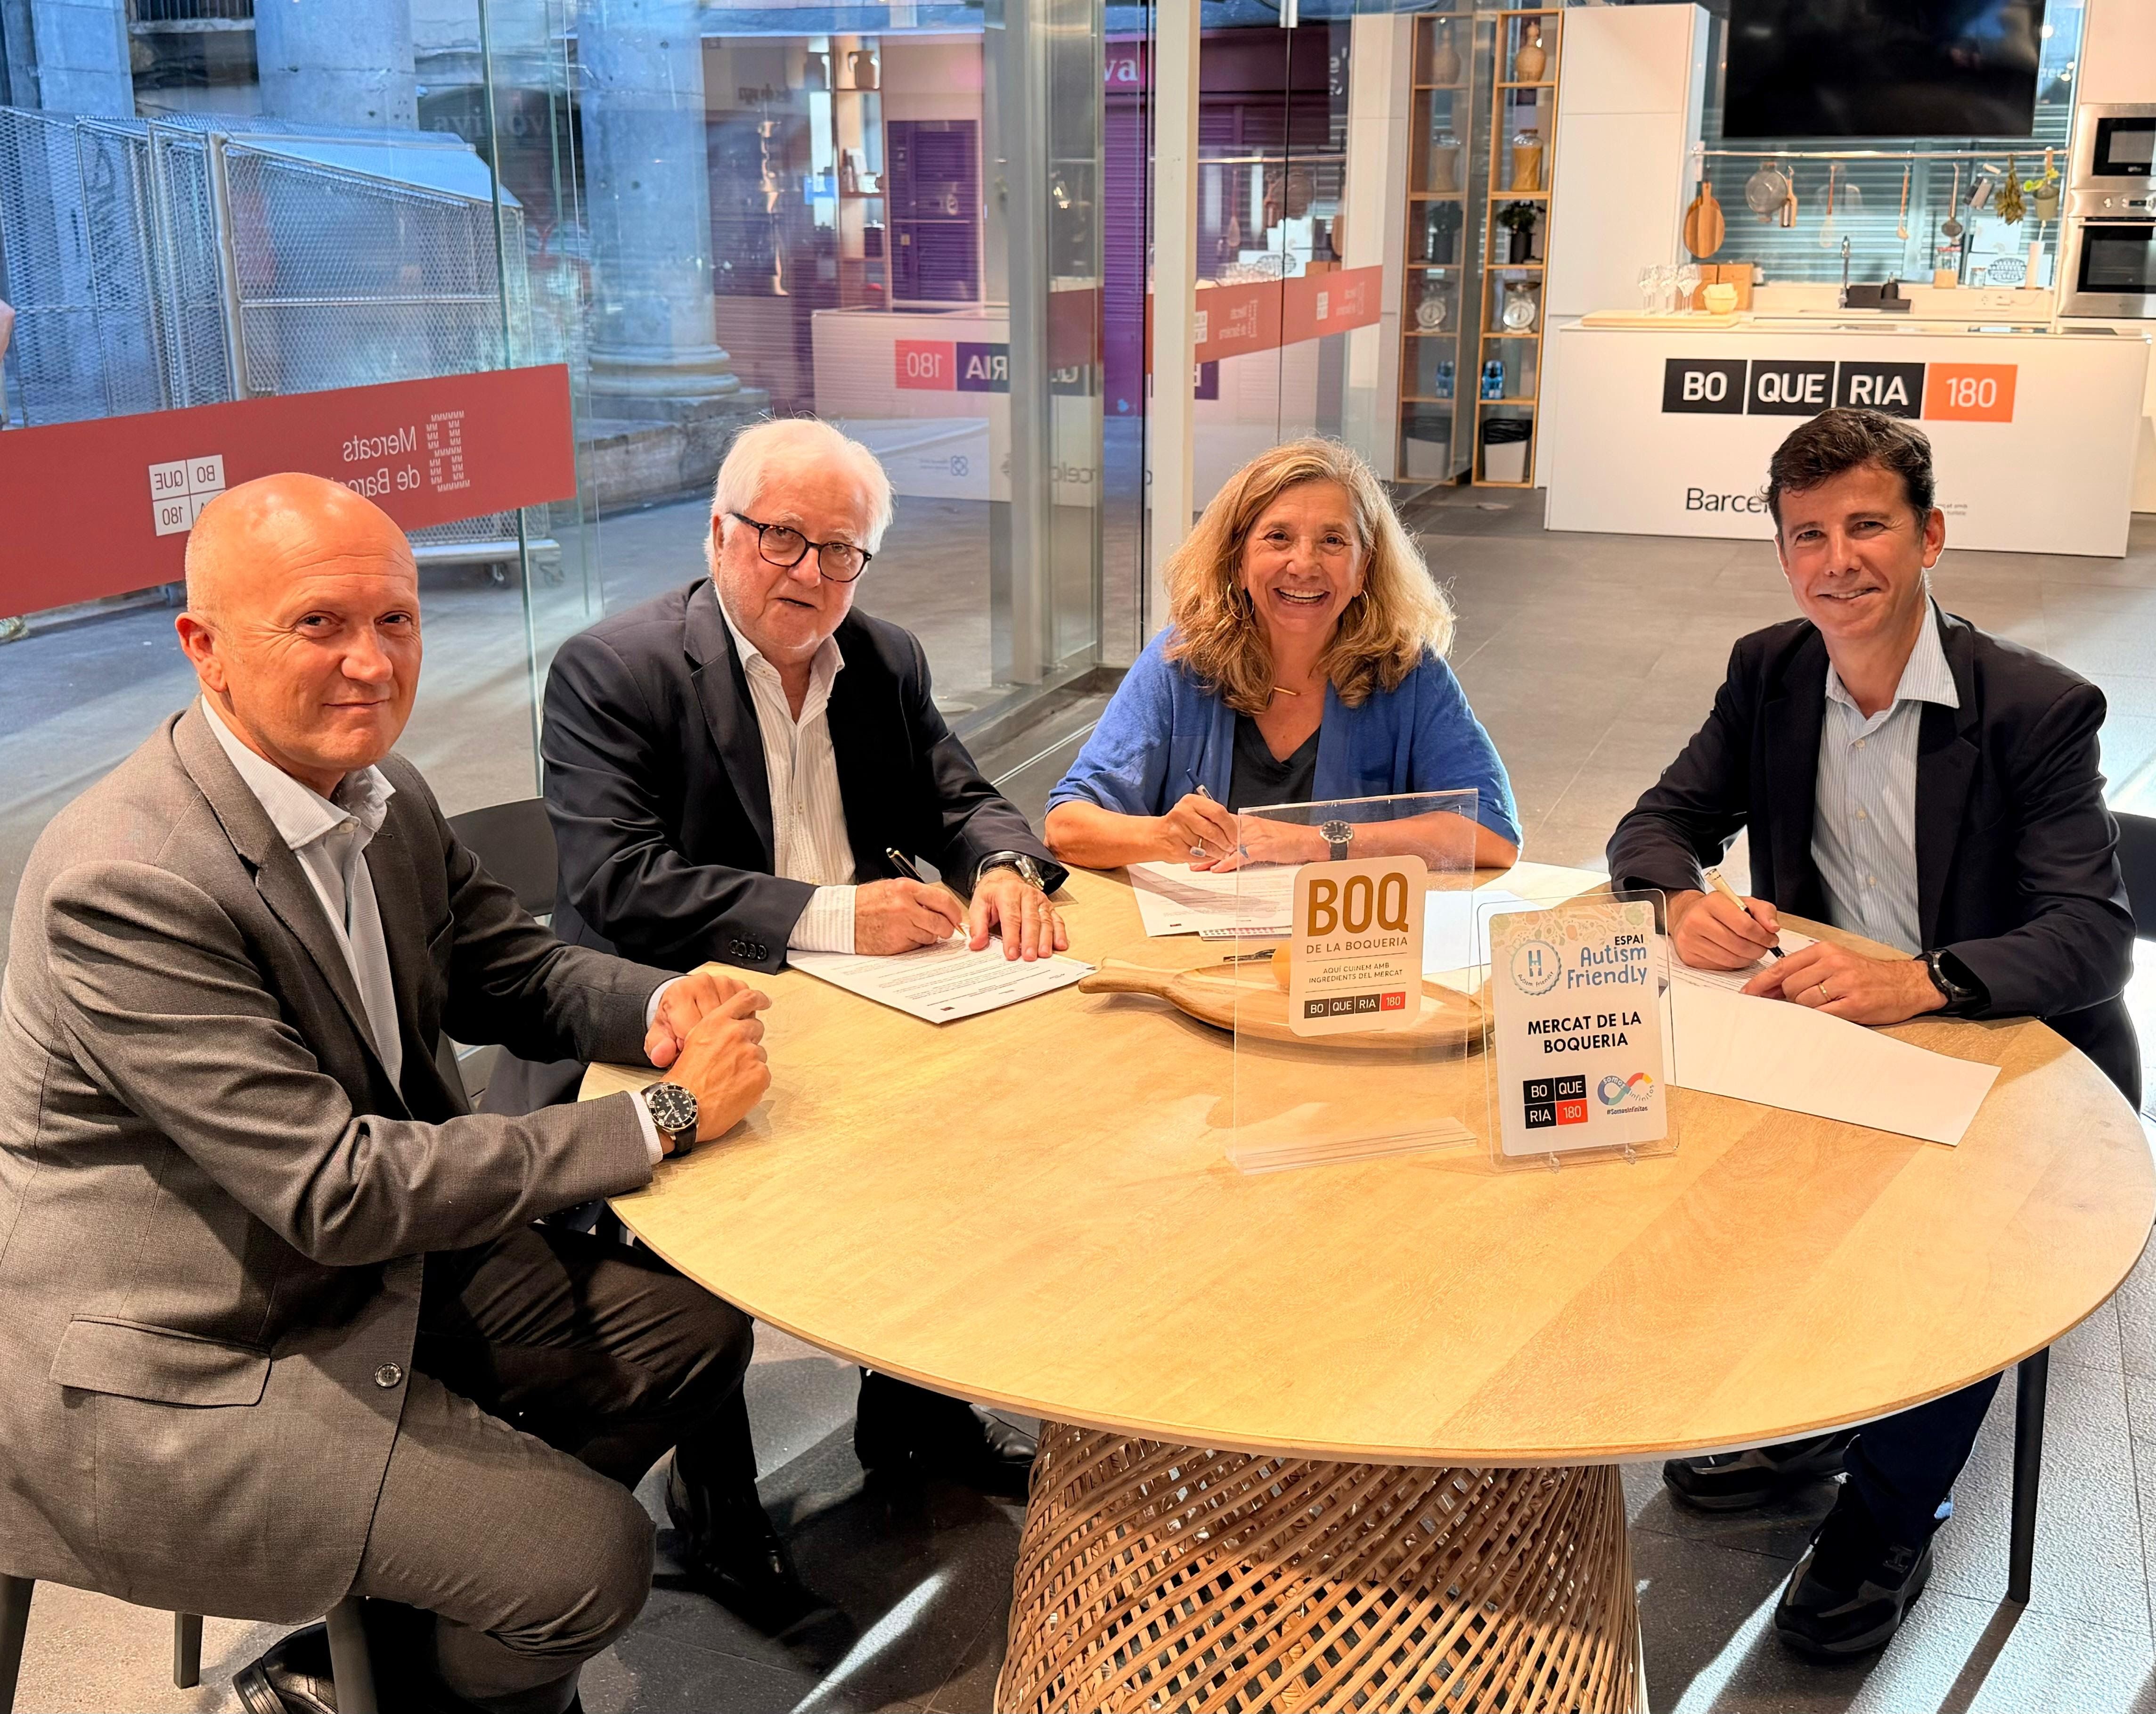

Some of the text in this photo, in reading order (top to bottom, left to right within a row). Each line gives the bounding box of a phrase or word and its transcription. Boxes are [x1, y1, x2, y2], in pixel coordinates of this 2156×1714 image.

[1682, 371, 1997, 408] BO QUE RIA 180
[1307, 872, 1408, 937] BOQ
[1307, 937, 1407, 954] DE LA BOQUERIA
[1615, 934, 1643, 945] ESPAI
[1581, 944, 1646, 967] Autism
[1309, 974, 1356, 983] INGREDIENTS
[1374, 969, 1403, 978] MERCAT
[1323, 965, 1341, 974] AQUÍ
[1344, 964, 1371, 972] CUINEM
[1310, 996, 1401, 1014] BO QUE RIA 180
[1528, 1011, 1642, 1035] MERCAT DE LA
[1544, 1033, 1628, 1053] BOQUERIA
[1531, 1081, 1583, 1098] BO QUE
[1530, 1106, 1582, 1122] RIA 180
